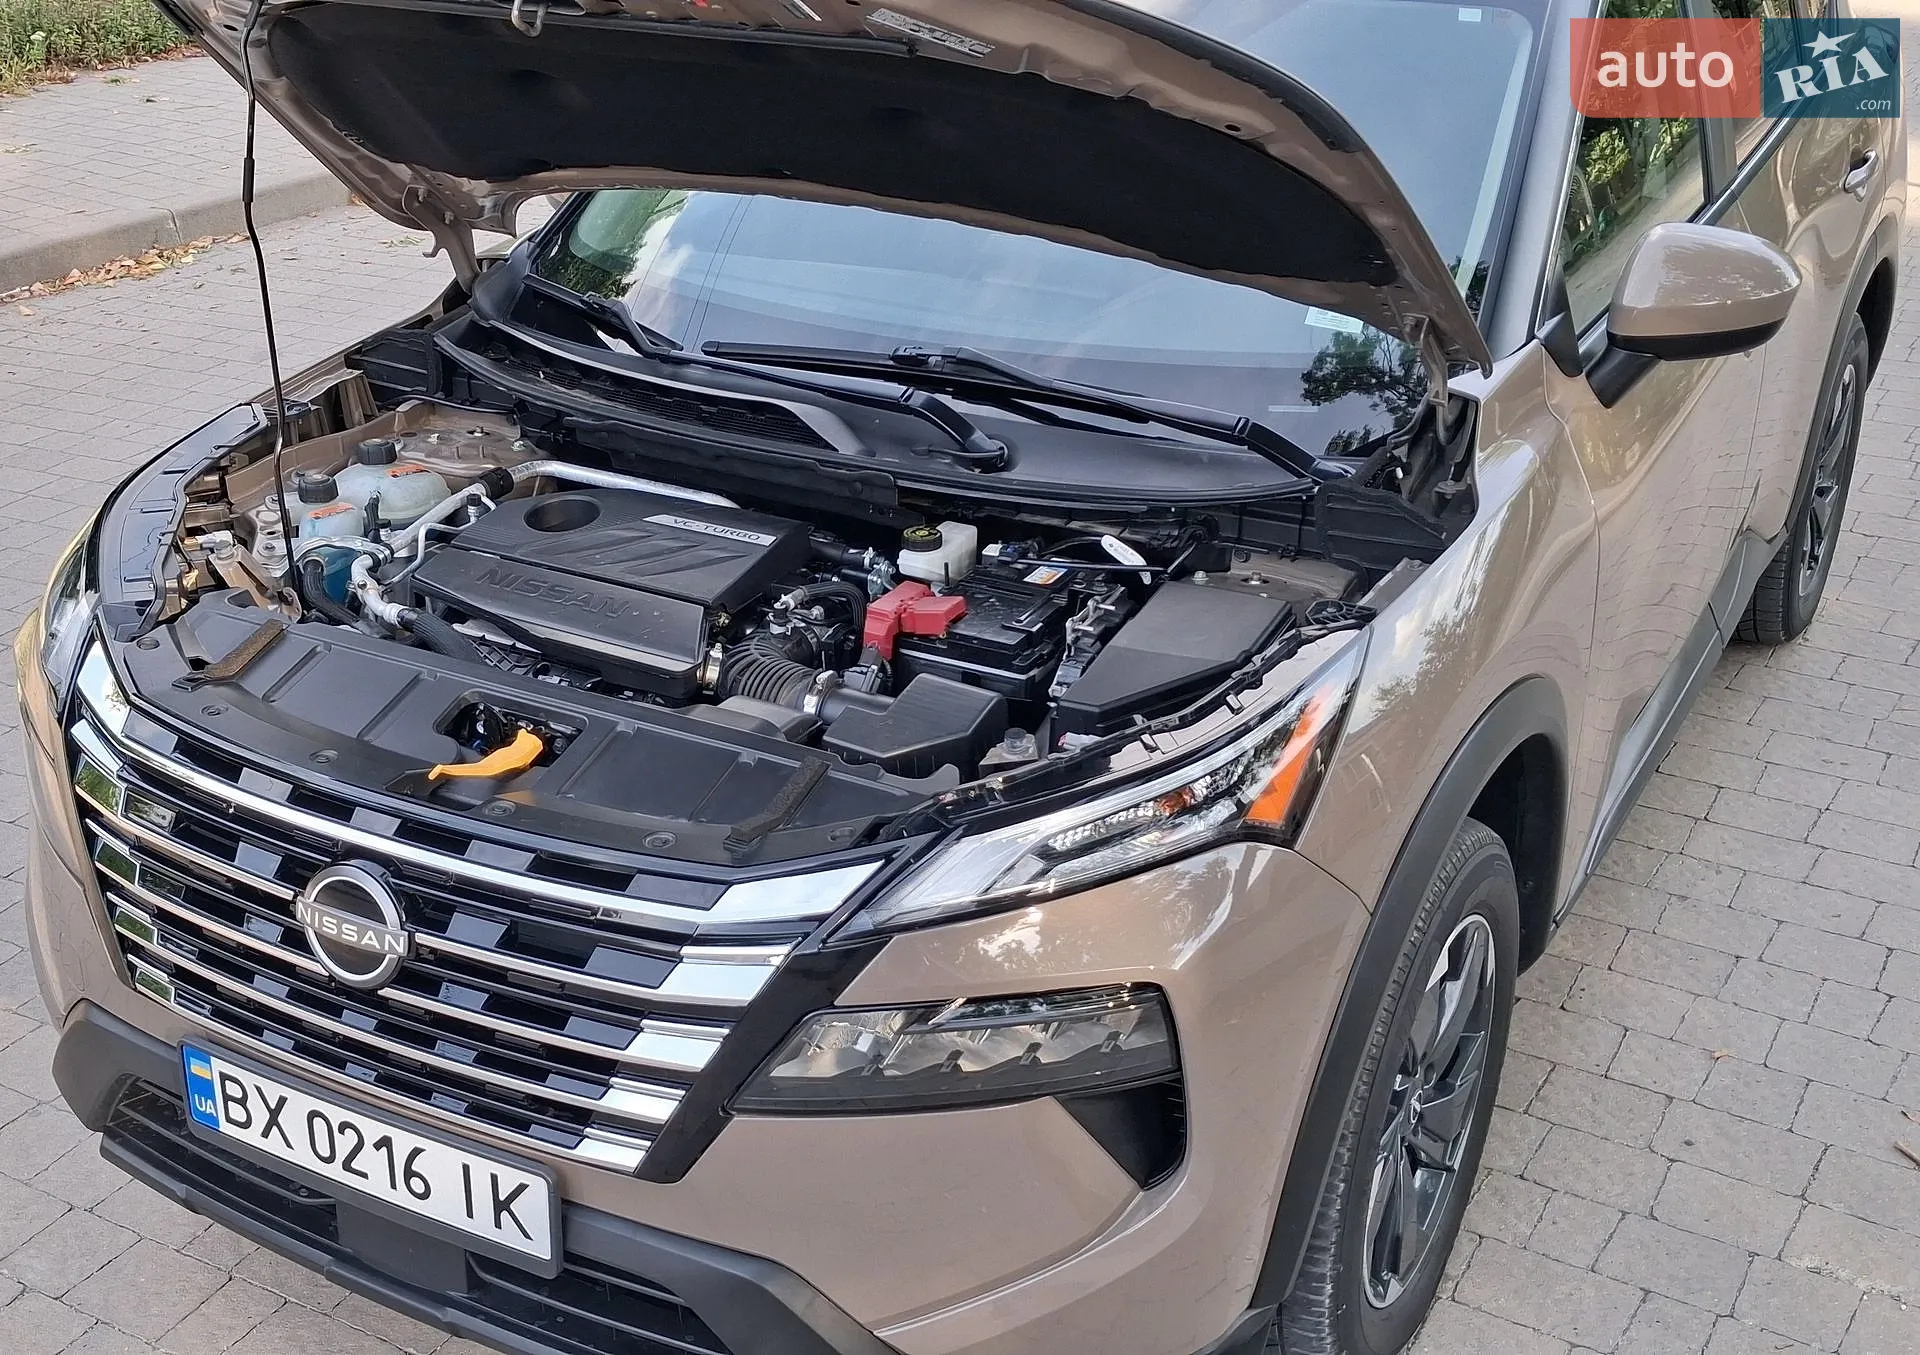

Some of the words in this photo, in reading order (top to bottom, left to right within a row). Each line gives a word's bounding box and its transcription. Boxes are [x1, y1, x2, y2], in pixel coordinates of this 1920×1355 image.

[673, 518, 761, 541] VC-TURBO
[476, 567, 631, 618] NISSAN
[298, 901, 405, 953] NISSAN
[195, 1093, 218, 1118] UA
[218, 1070, 294, 1151] BX
[306, 1108, 432, 1201] 0216
[461, 1162, 534, 1241] IK
